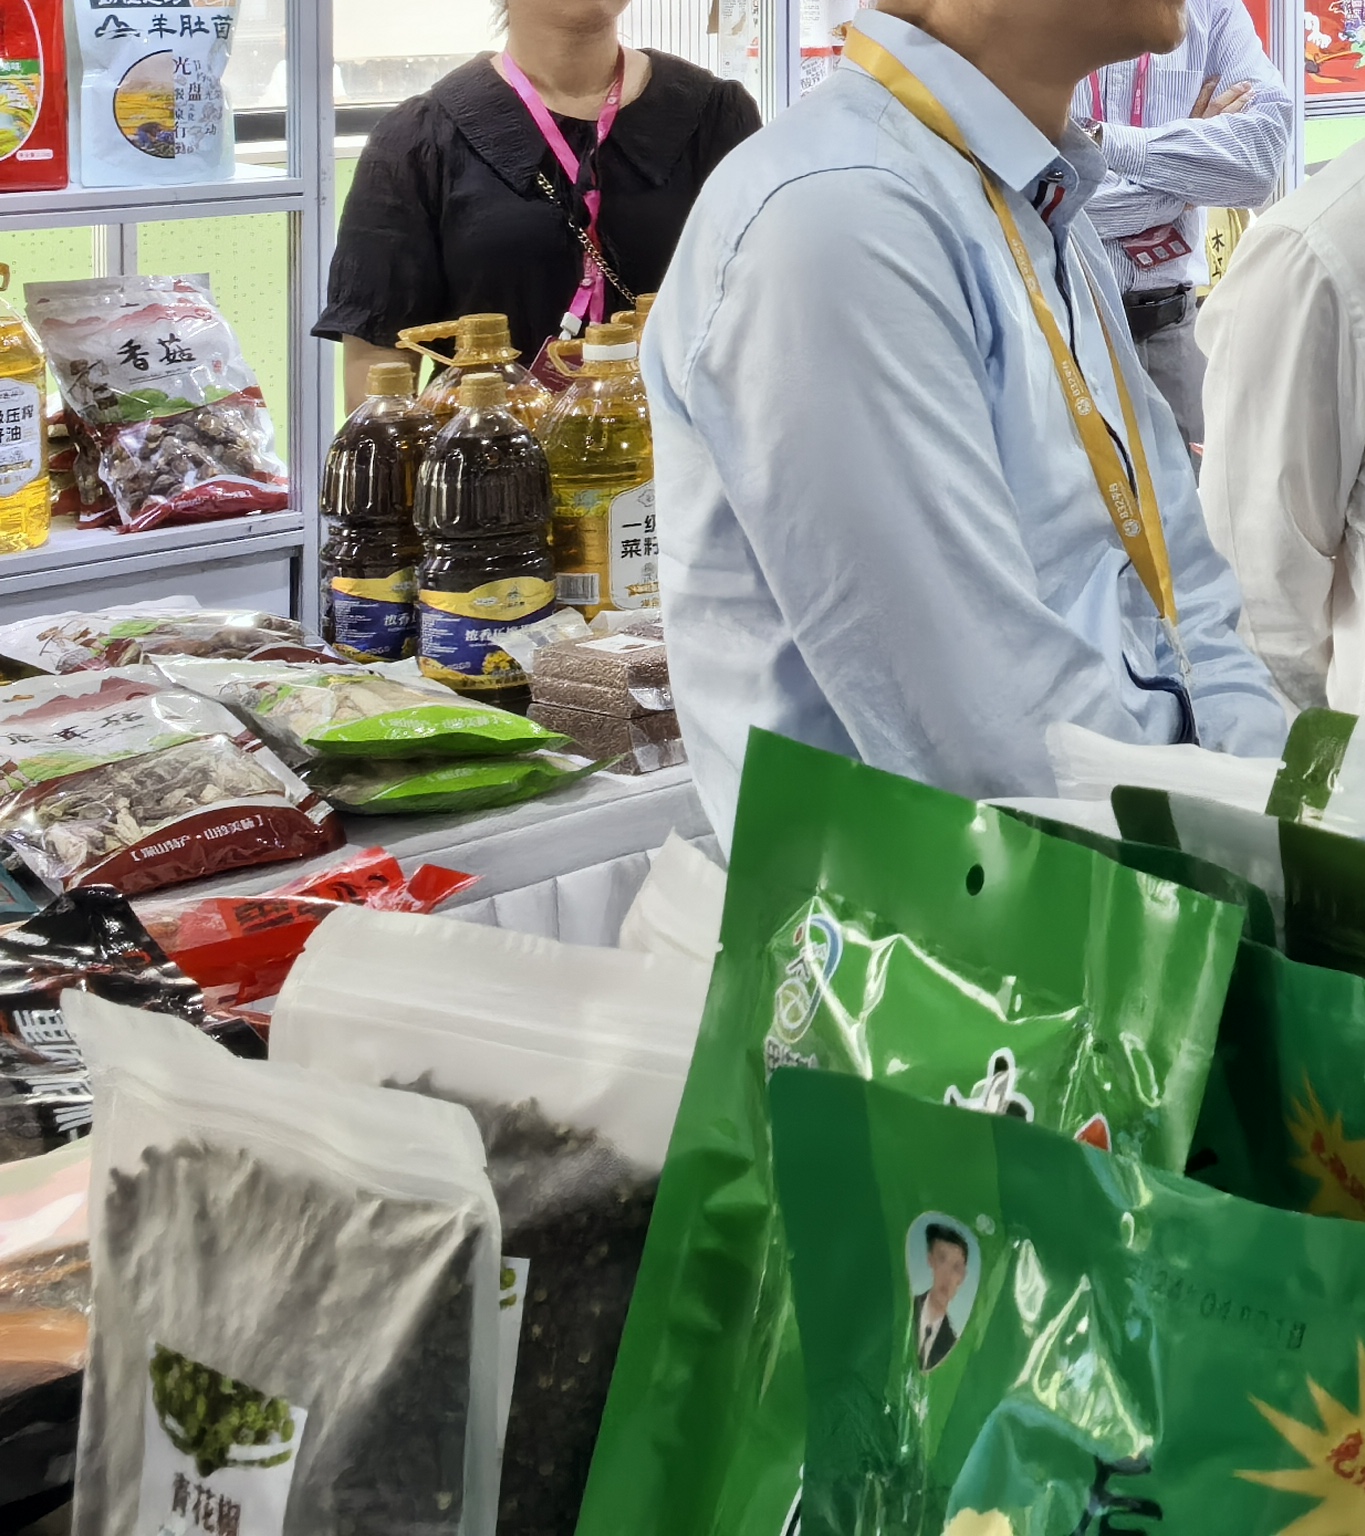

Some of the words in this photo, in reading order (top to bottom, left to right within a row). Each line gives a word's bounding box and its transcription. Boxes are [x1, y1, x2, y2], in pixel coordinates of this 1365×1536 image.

[148, 13, 234, 40] 羊肚菌
[117, 332, 196, 372] 香菇
